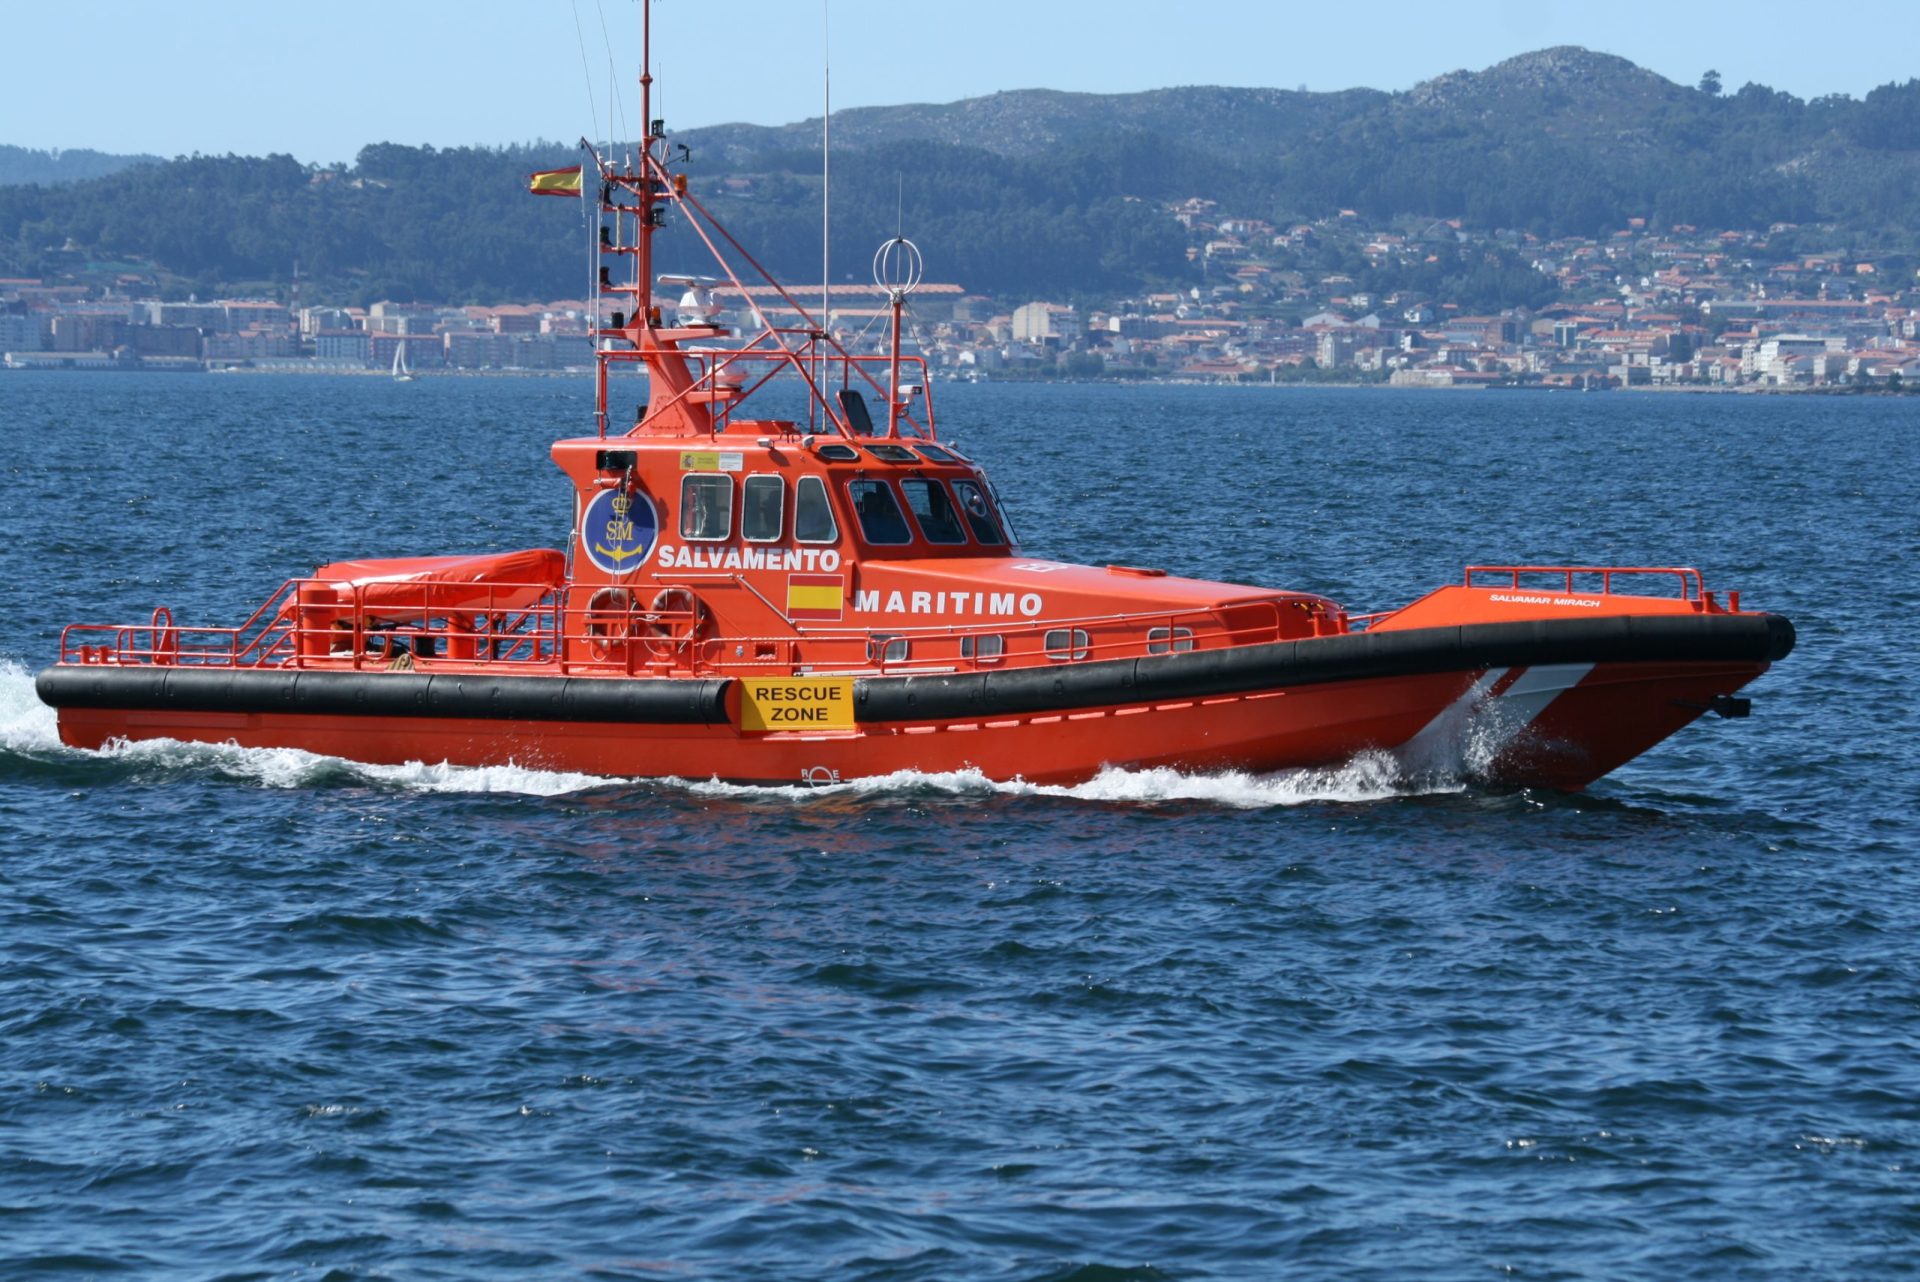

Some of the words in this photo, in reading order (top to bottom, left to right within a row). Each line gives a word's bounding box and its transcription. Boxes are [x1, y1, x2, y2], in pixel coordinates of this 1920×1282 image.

[606, 520, 634, 541] SM
[658, 545, 841, 572] SALVAMENTO
[854, 590, 1043, 616] MARITIMO
[1489, 594, 1551, 605] SALVAMAR
[1553, 598, 1600, 607] MIRACH
[756, 686, 841, 701] RESCUE
[771, 707, 828, 721] ZONE
